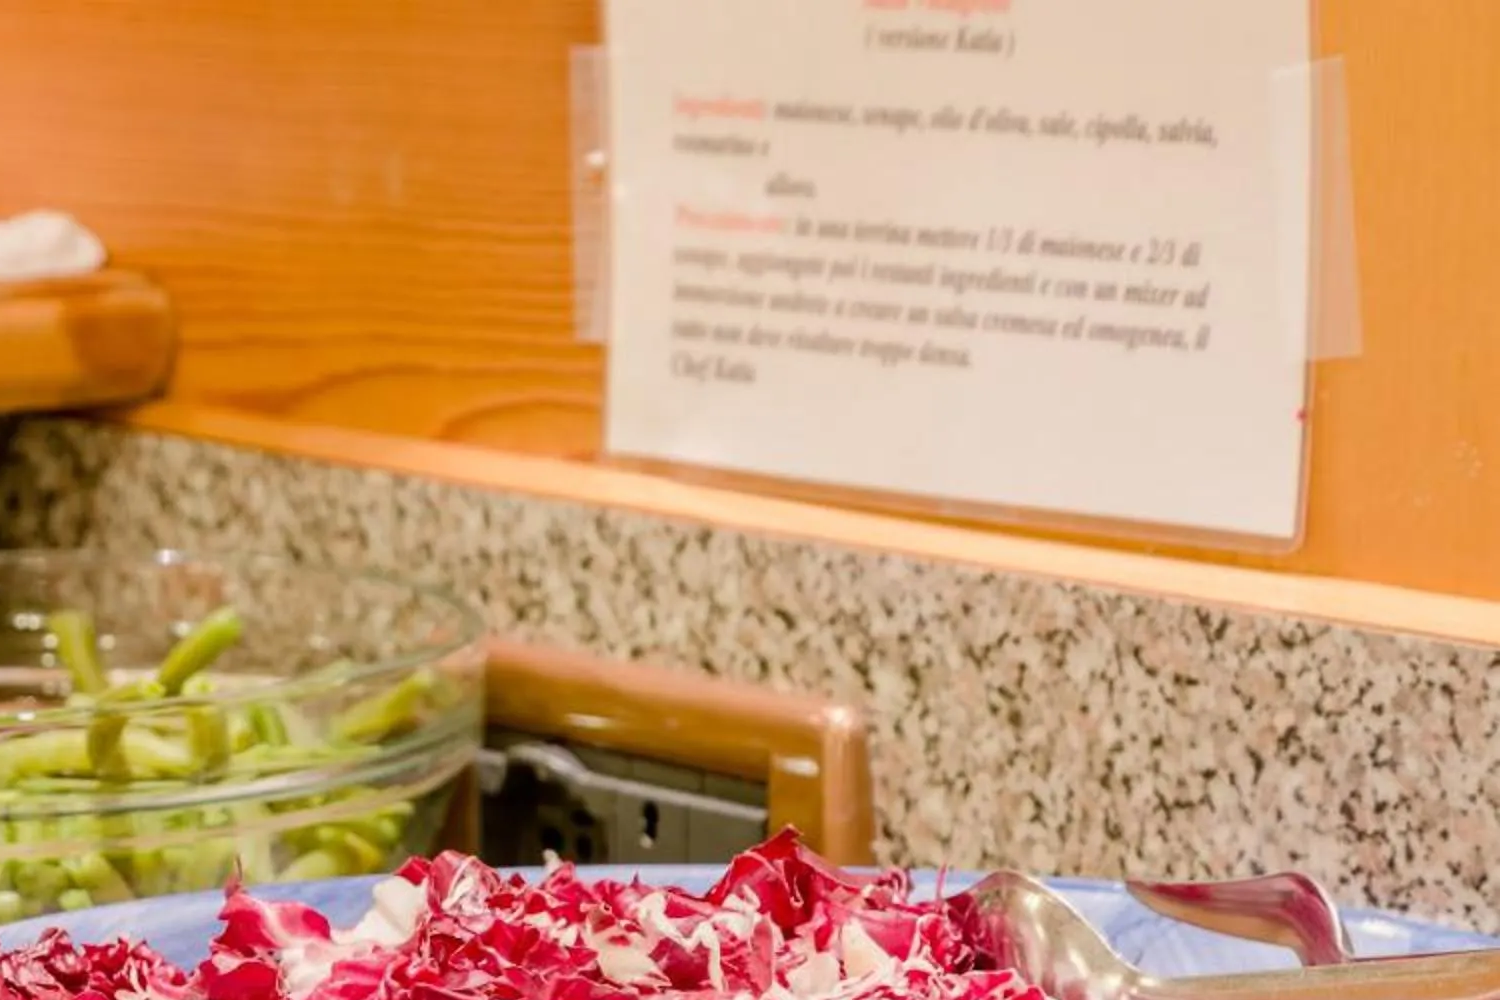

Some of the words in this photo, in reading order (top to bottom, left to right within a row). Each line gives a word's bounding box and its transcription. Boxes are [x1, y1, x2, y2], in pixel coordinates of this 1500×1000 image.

[954, 25, 1002, 53] Katia
[1084, 112, 1151, 148] cipolla,
[1157, 116, 1218, 149] salvia,
[985, 227, 1013, 253] 1/3
[1017, 229, 1035, 254] di
[1039, 232, 1125, 262] maionese
[1130, 244, 1141, 263] e
[1147, 238, 1176, 266] 2/3
[1180, 241, 1201, 268] di
[1093, 281, 1117, 303] un
[1123, 279, 1179, 306] mixer
[1183, 281, 1210, 309] ad
[981, 312, 1058, 337] cremosa
[1062, 314, 1086, 340] ed
[1088, 322, 1189, 352] omogenea,
